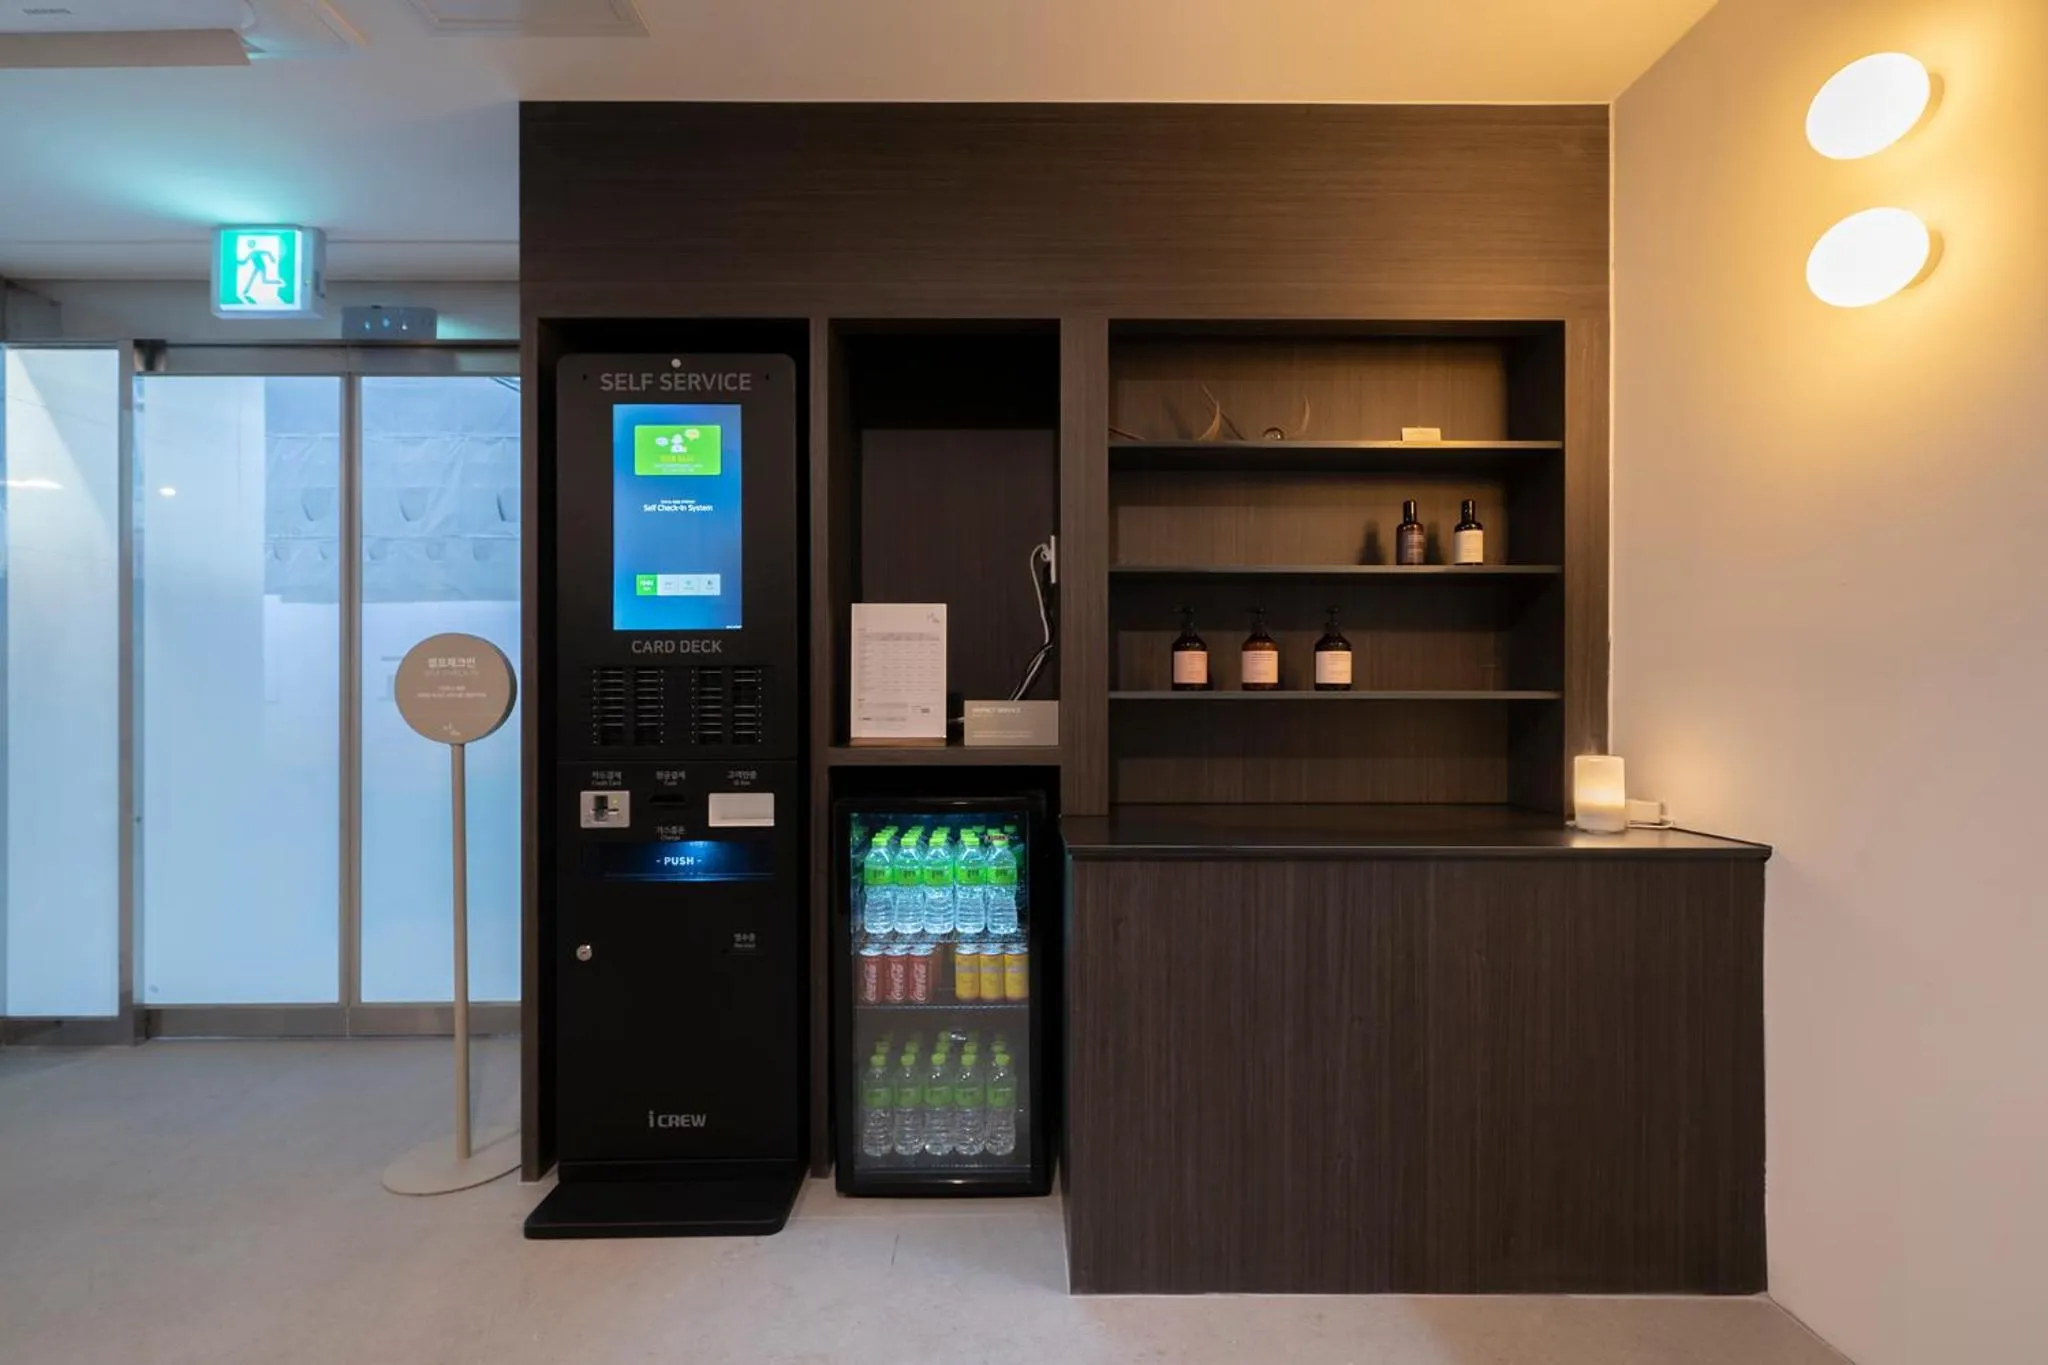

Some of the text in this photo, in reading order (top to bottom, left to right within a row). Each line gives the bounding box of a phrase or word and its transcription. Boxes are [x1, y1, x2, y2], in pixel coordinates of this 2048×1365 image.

[600, 372, 752, 391] SELF SERVICE
[631, 639, 722, 653] CARD DECK
[428, 657, 476, 668] 셀프체크인
[664, 856, 695, 866] PUSH
